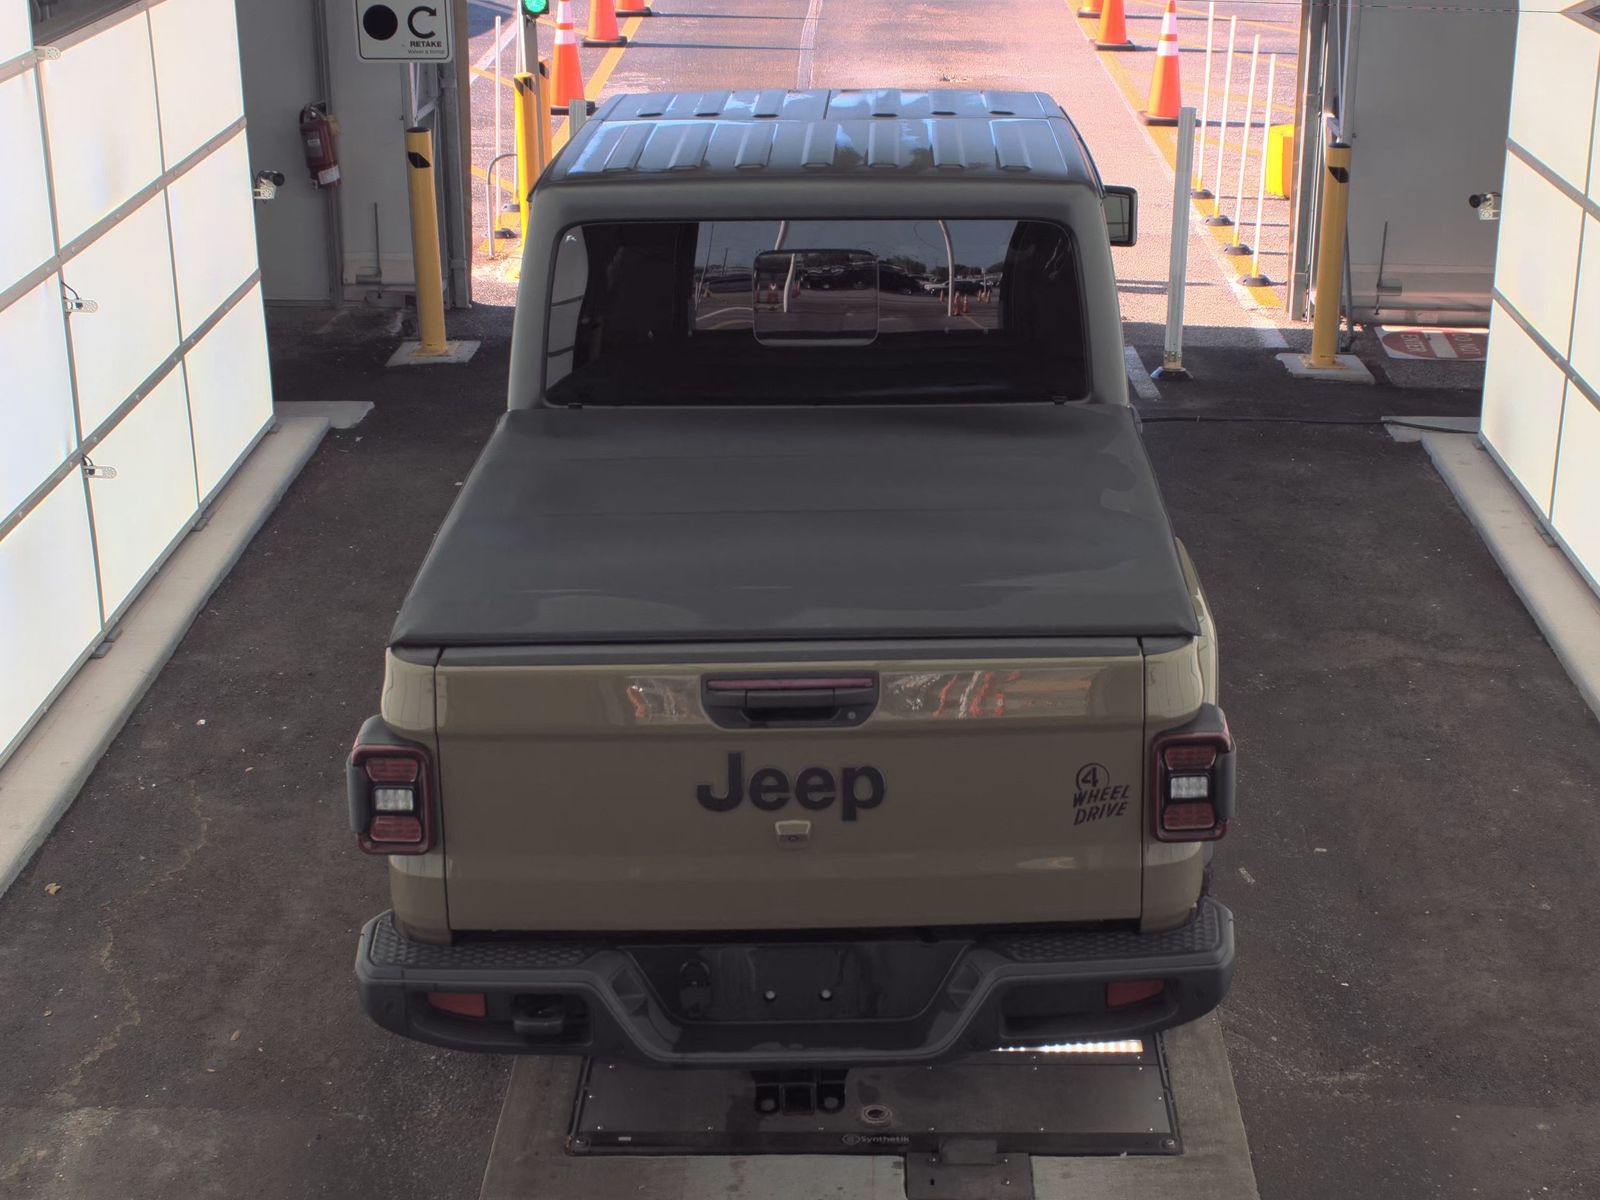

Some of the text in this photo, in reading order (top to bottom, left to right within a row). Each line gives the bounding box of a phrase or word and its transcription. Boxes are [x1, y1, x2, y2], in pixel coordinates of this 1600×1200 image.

[697, 752, 885, 821] Jeep
[1081, 767, 1099, 788] 4
[1073, 785, 1130, 809] WHEEL
[1073, 801, 1129, 826] DRIVE
